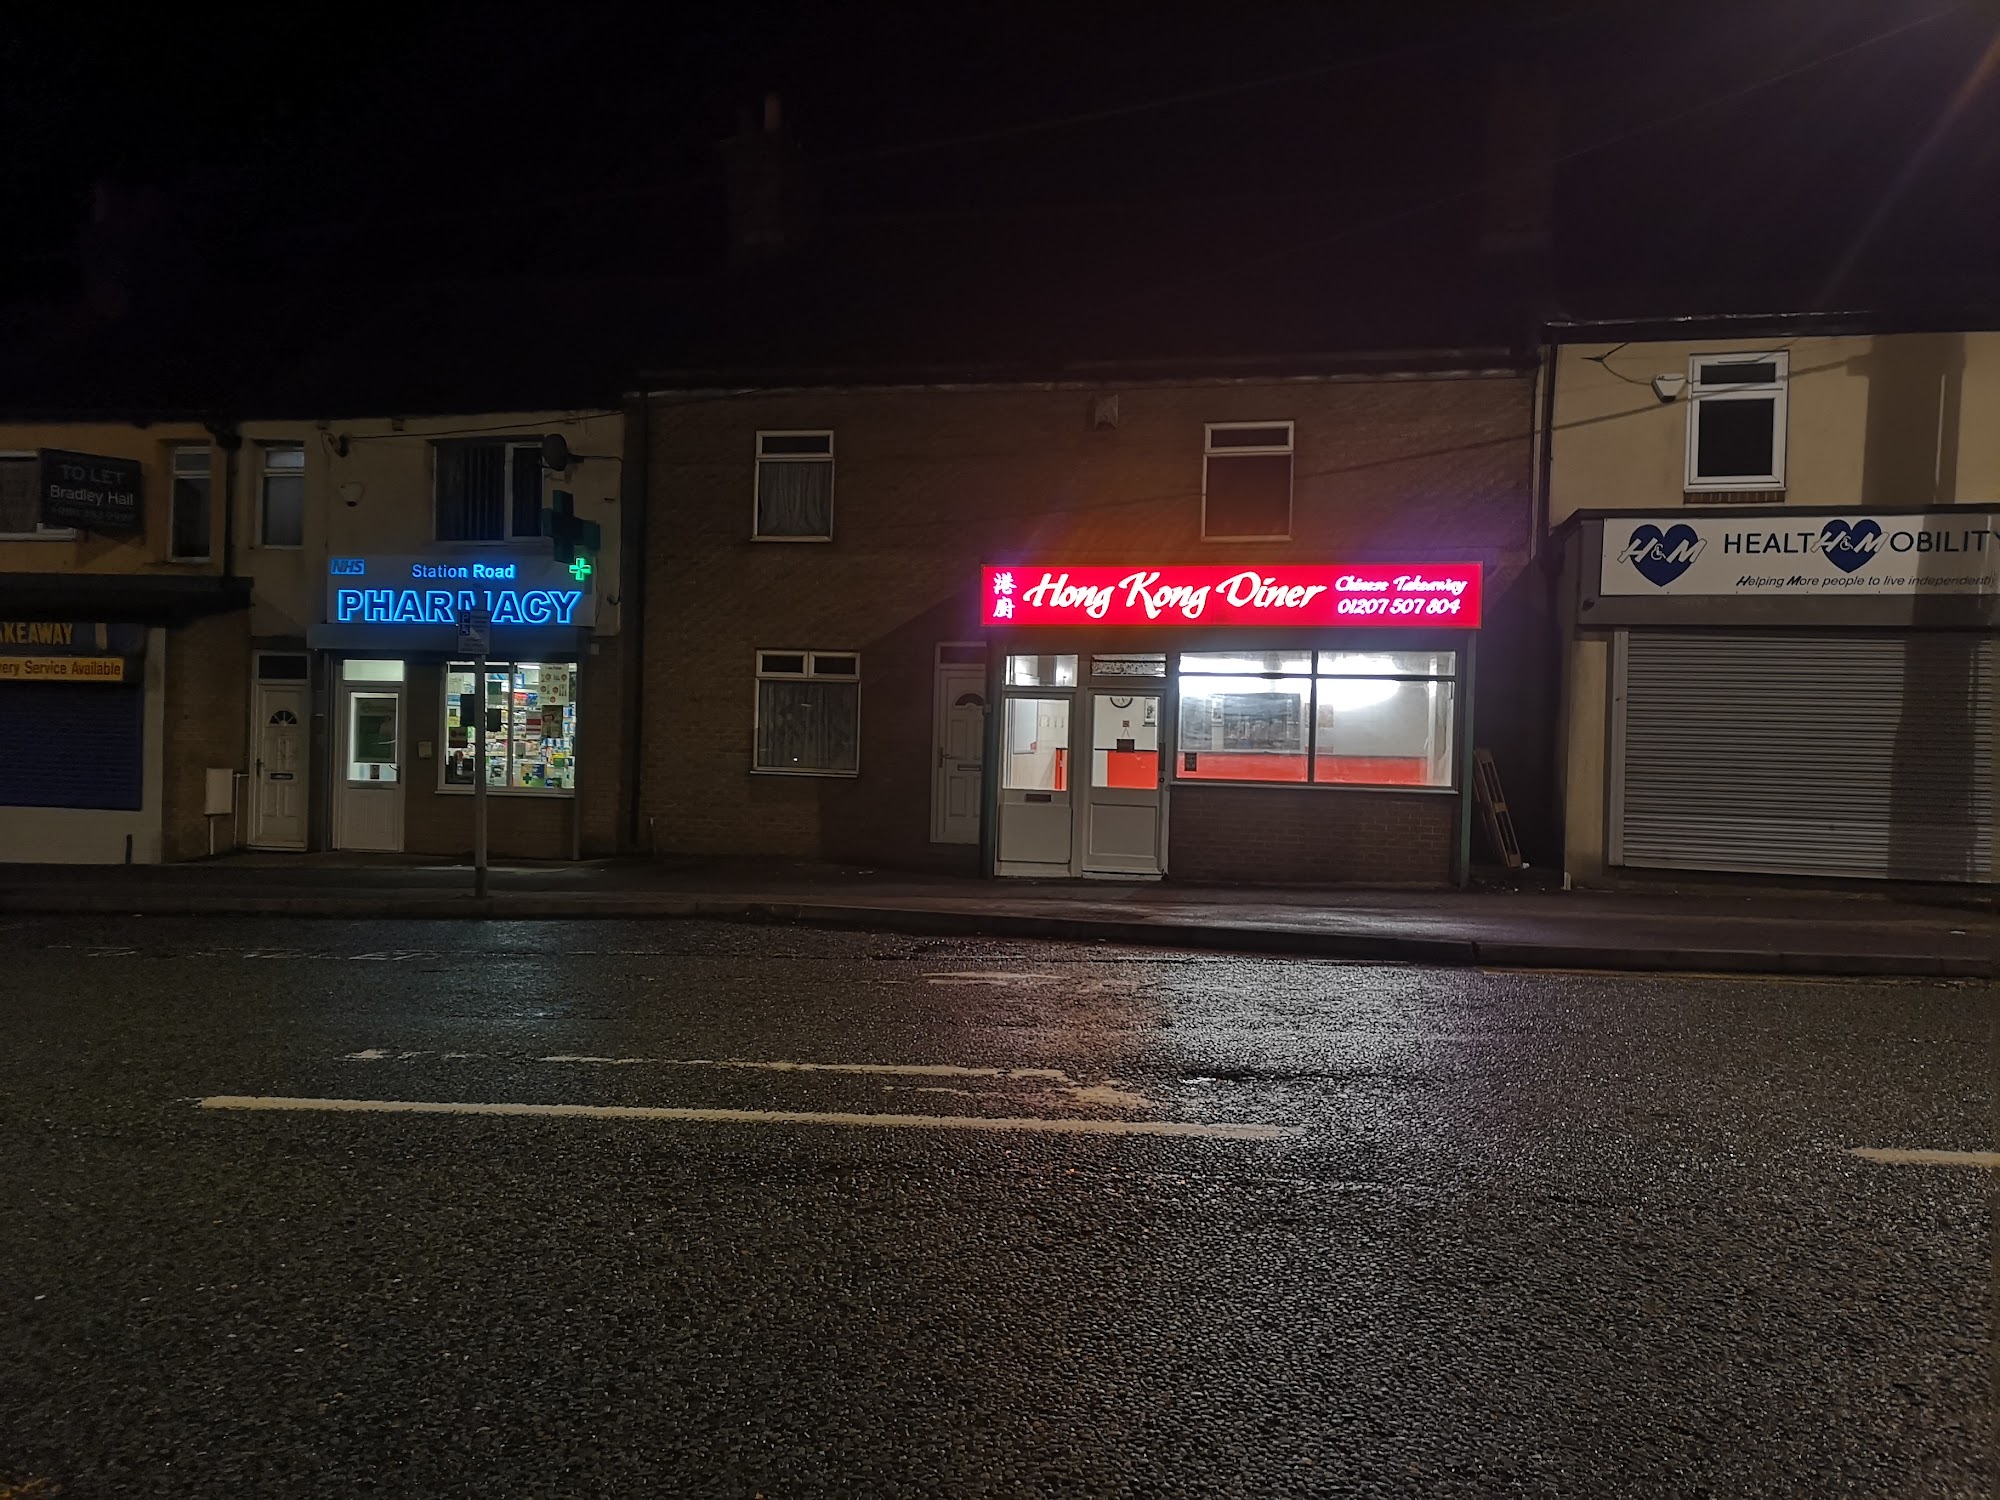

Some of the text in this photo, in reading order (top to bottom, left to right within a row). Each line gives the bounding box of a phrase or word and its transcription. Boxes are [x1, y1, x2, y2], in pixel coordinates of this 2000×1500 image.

[56, 464, 128, 484] TO LET
[50, 484, 134, 506] Bradley Hall
[331, 560, 364, 573] NHS
[412, 564, 515, 579] Station Road
[1335, 575, 1390, 592] Chinese
[1736, 575, 1785, 588] Helping
[1785, 575, 1819, 587] More
[1822, 575, 1865, 588] people
[1868, 576, 1881, 586] to
[1883, 575, 1904, 586] live
[1022, 571, 1328, 620] Hong Kong Diner
[1337, 598, 1461, 615] 01207 507 804
[25, 660, 67, 675] Service
[71, 661, 122, 676] Available
